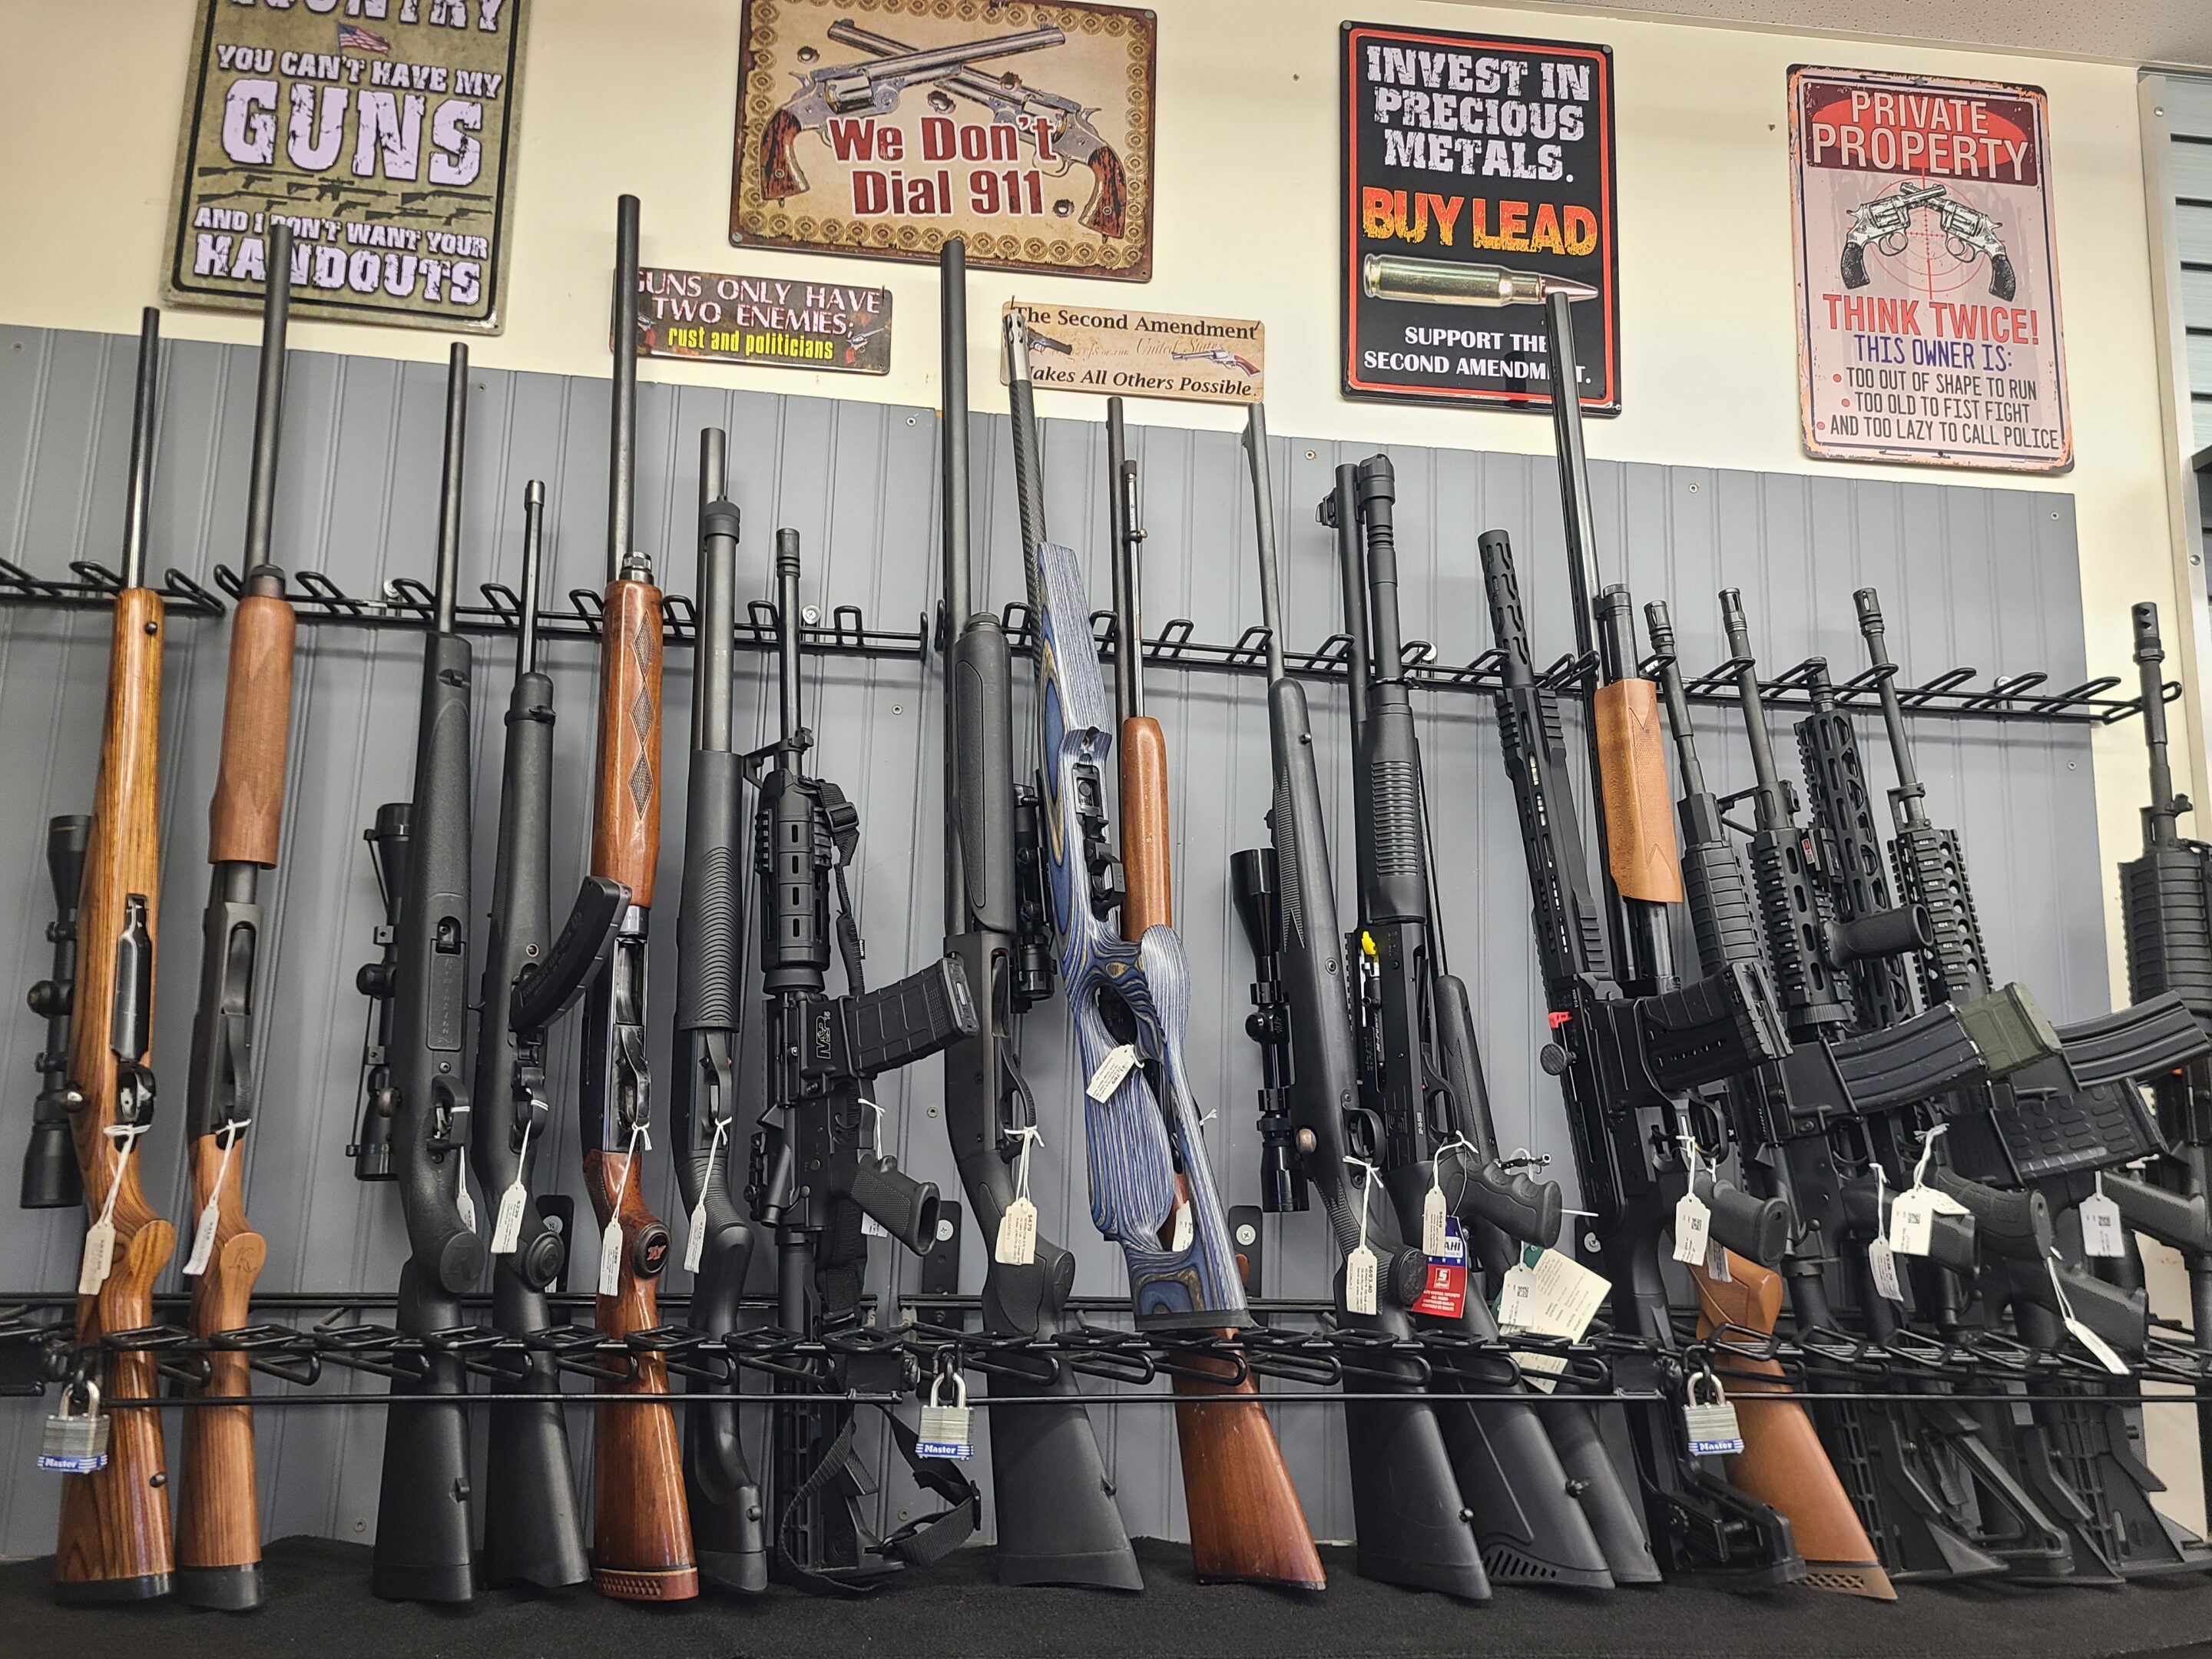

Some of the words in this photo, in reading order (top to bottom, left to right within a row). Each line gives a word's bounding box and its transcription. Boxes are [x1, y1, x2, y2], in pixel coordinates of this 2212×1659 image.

[217, 45, 275, 73] YOU
[281, 51, 366, 83] CAN'T
[372, 61, 447, 92] HAVE
[454, 70, 502, 98] MY
[1366, 45, 1528, 97] INVEST
[1540, 62, 1590, 101] IN
[1374, 86, 1584, 142] PRECIOUS
[1851, 90, 1988, 134] PRIVATE
[221, 78, 483, 186] GUNS
[830, 118, 904, 162] We
[921, 117, 1058, 162] Don't
[1384, 129, 1574, 183] METALS.
[1812, 123, 2028, 181] PROPERTY
[852, 170, 952, 215] Dial
[970, 169, 1044, 215] 911
[194, 207, 249, 232] AND
[254, 212, 264, 233] I
[347, 222, 422, 250] WANT
[426, 230, 488, 260] YOUR
[1362, 186, 1465, 247] BUY
[1472, 197, 1598, 257] LEAD
[652, 297, 722, 323] TWO
[717, 279, 792, 306] ONLY
[806, 286, 881, 314] HAVE
[1058, 310, 1128, 329] Second
[1134, 316, 1257, 339] Amendment
[1405, 326, 1504, 349] SUPPORT
[1823, 293, 1922, 336] THINK
[1929, 301, 2038, 345] TWICE!
[668, 326, 704, 349] rust
[711, 330, 740, 352] and
[746, 333, 834, 360] politicians
[1364, 350, 1449, 373] SECOND
[1853, 334, 1906, 364] THIS
[1912, 339, 1975, 369] OWNER
[1982, 344, 2012, 372] IS:
[1030, 366, 1075, 382] akes
[1080, 369, 1108, 385] All
[1113, 371, 1174, 390] Others
[1179, 377, 1257, 396] Possible.
[1846, 366, 1874, 388] TOO
[1879, 369, 1906, 391] OUT
[1912, 371, 1930, 392] OF
[1936, 373, 1982, 397] SHAPE
[1986, 376, 2004, 398] TO
[2009, 379, 2037, 401] RUN
[1854, 391, 1883, 413] TOO
[1888, 393, 1916, 416] OLD
[1920, 396, 1939, 417] TO
[1944, 398, 1980, 420] FIST
[1985, 400, 2030, 424] FIGHT
[1830, 414, 1859, 436] AND
[1863, 416, 1892, 439] TOO
[1896, 419, 1933, 441] LAZY
[1939, 421, 1958, 443] TO
[1962, 423, 2000, 446] CALL
[2004, 426, 2060, 450] POLICE
[44, 1457, 78, 1469] Master
[924, 1443, 957, 1455] Master
[1698, 1441, 1734, 1452] Master
